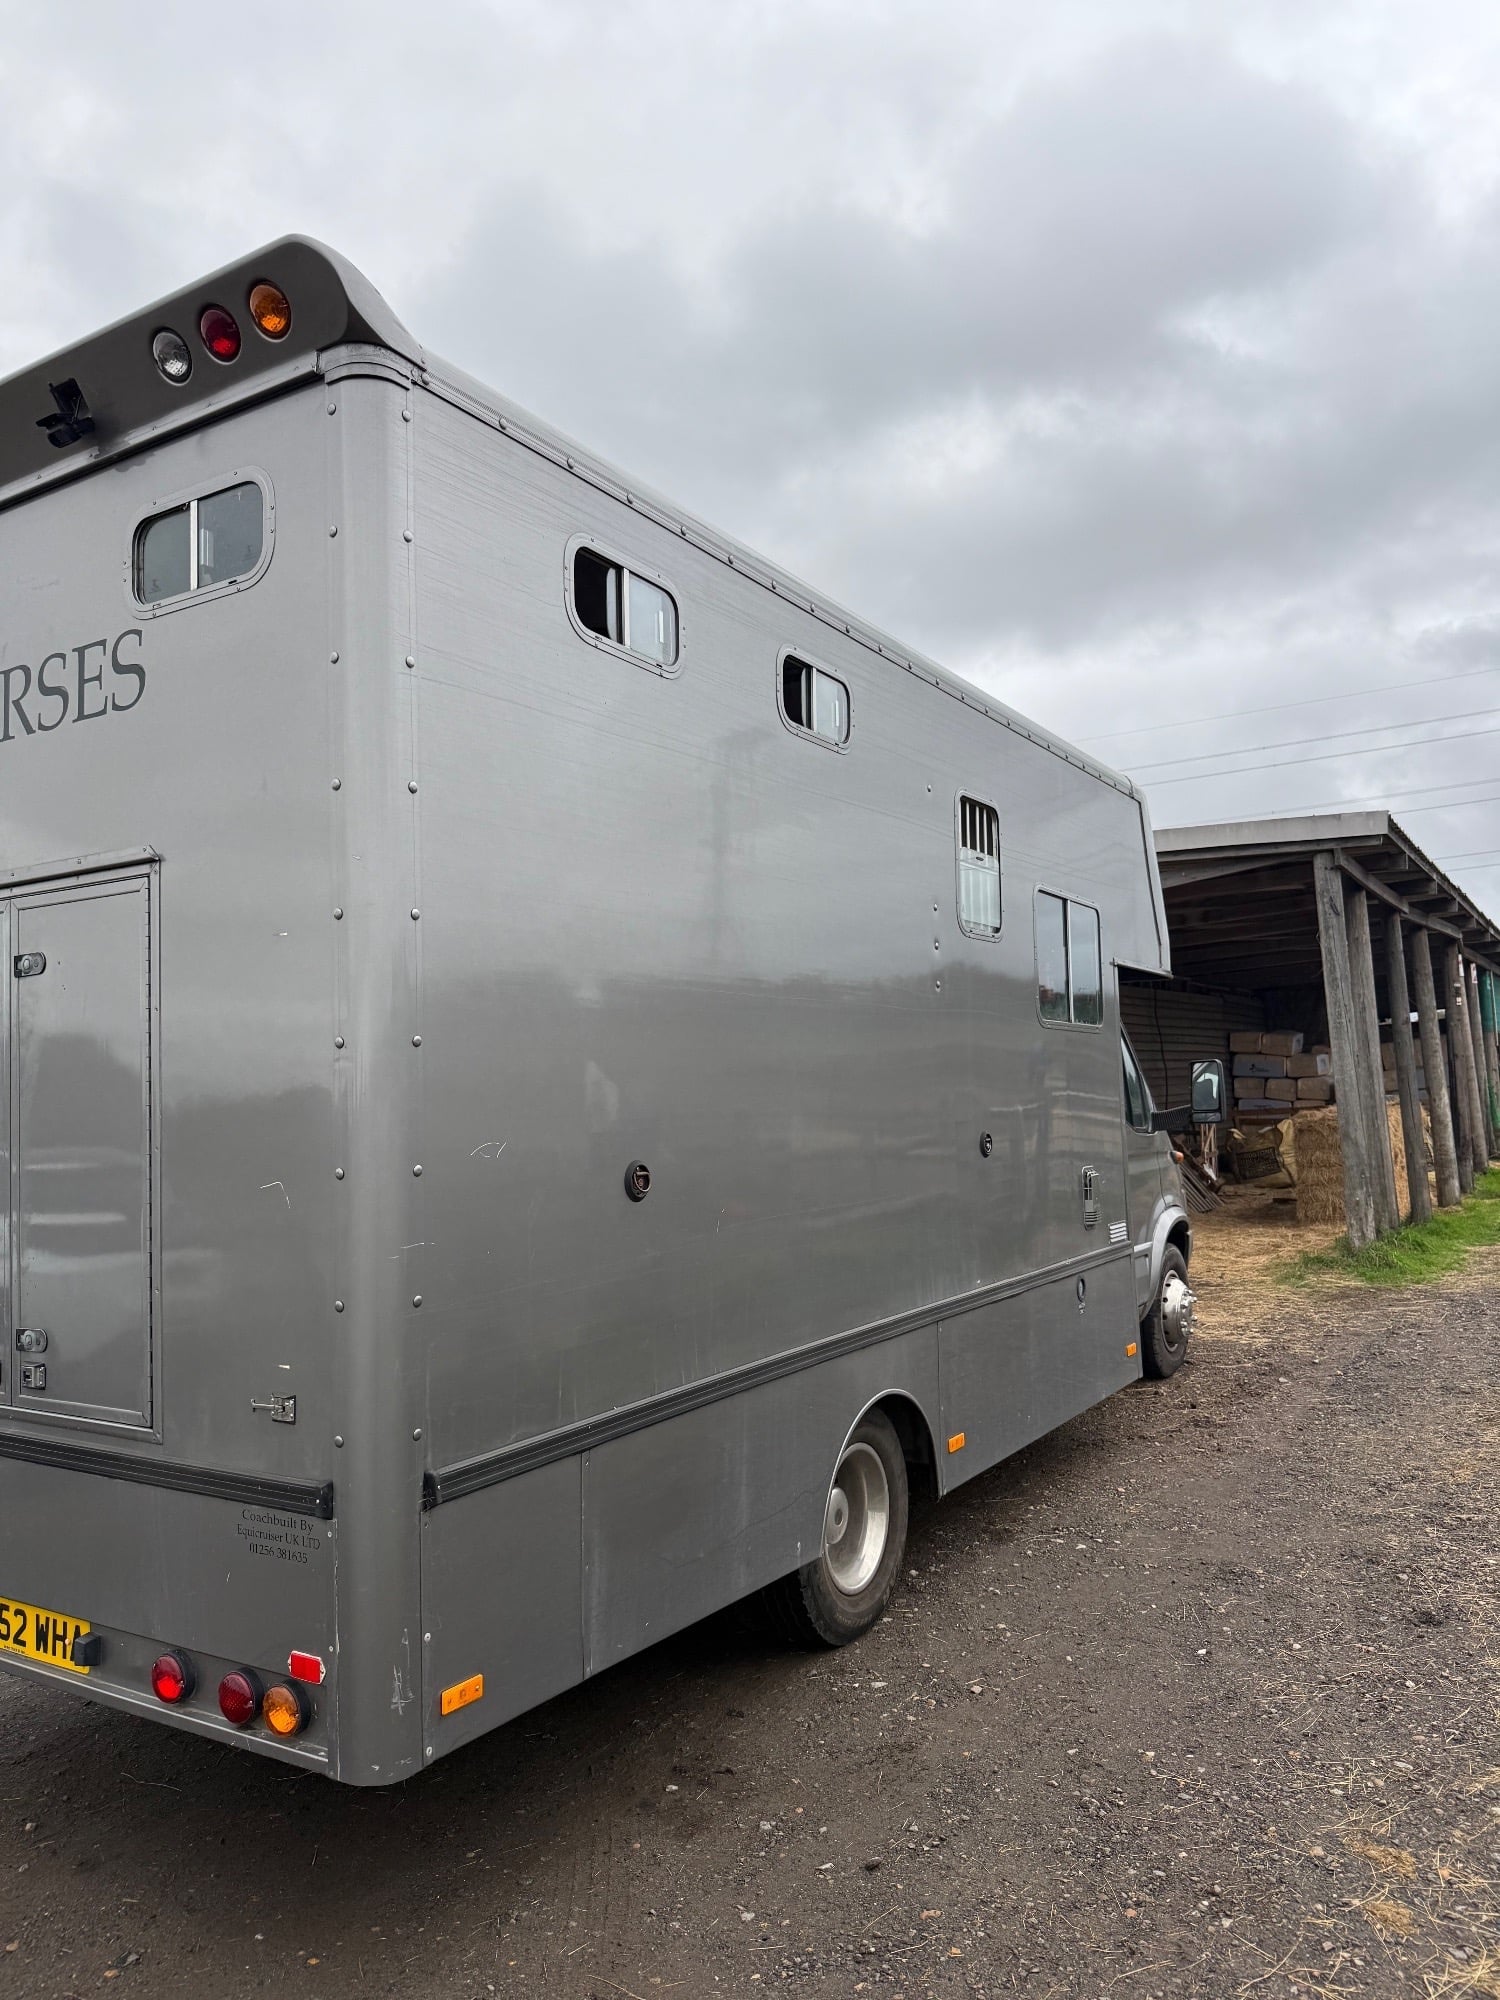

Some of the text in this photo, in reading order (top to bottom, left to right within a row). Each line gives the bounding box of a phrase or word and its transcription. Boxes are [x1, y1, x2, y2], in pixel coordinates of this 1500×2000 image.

[0, 629, 146, 742] RSES
[242, 1508, 314, 1535] Coachbuilt By
[237, 1523, 321, 1551] Equicruiser UK LTD
[249, 1542, 308, 1564] 01256 381635
[0, 1603, 27, 1648] 52
